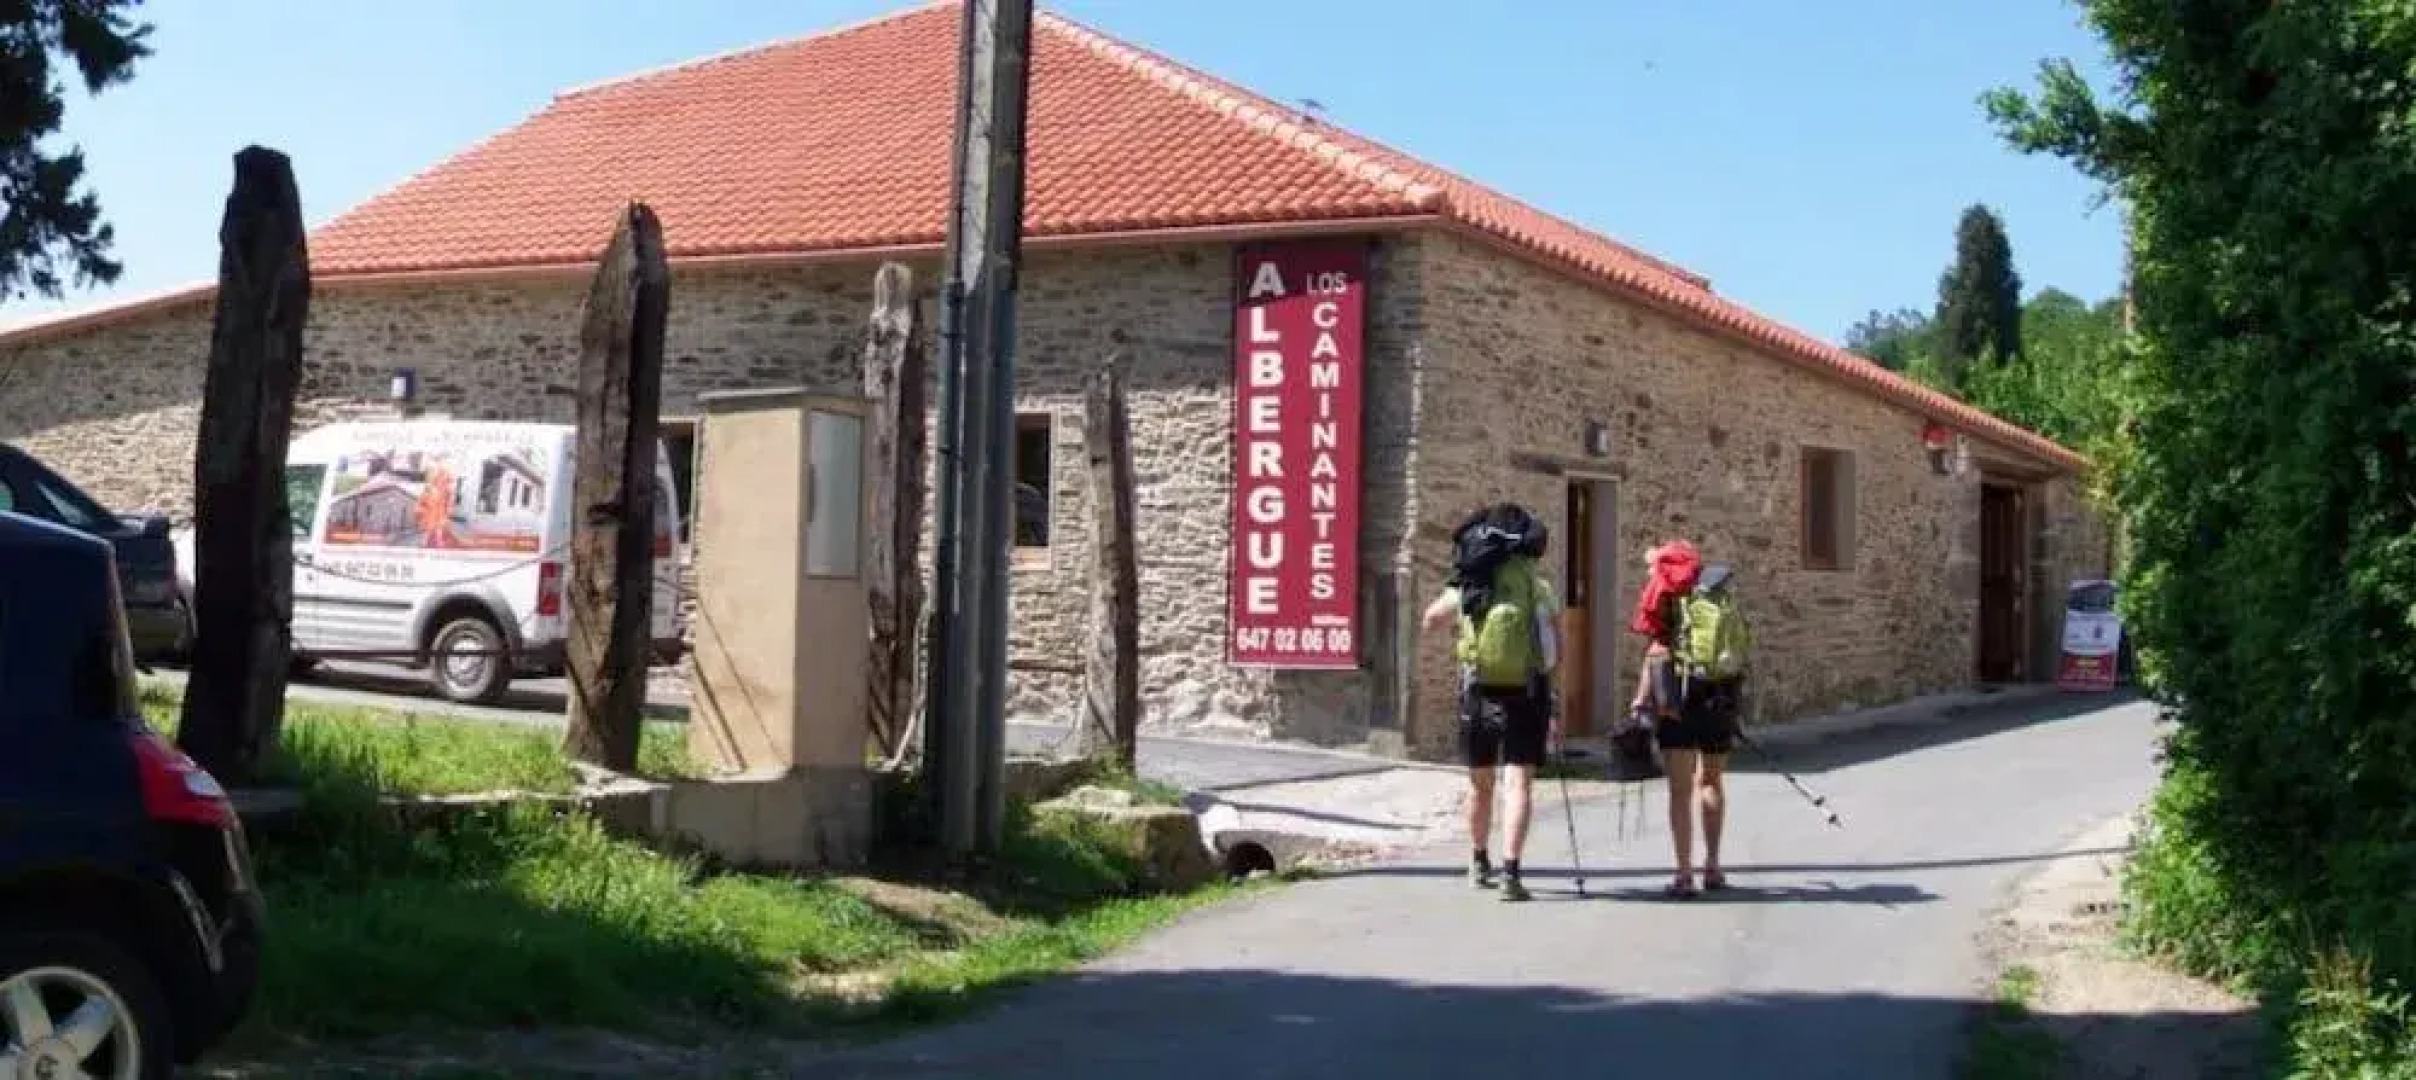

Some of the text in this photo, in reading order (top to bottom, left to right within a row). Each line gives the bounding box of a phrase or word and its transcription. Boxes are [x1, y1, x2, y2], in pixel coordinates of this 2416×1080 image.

[1307, 272, 1347, 294] LOS
[1248, 262, 1285, 613] ALBERGUE
[1311, 302, 1339, 598] CAMINANTES
[1237, 627, 1270, 651] 647
